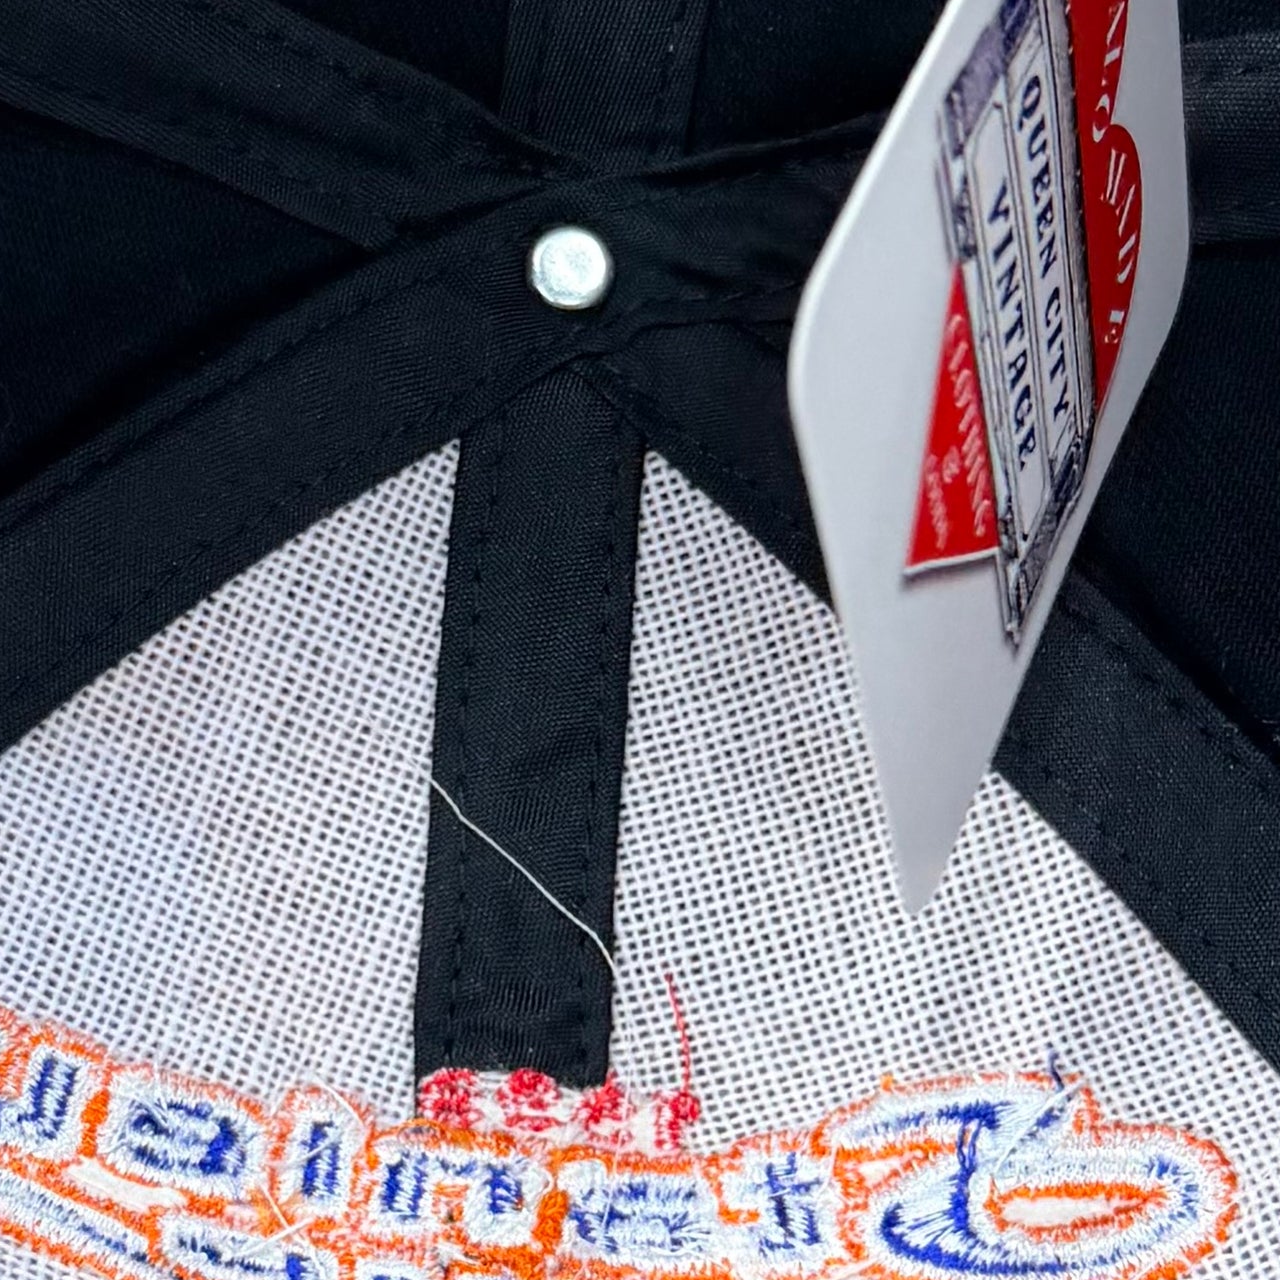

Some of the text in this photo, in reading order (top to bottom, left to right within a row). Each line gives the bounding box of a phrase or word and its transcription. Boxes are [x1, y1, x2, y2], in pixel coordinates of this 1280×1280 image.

[987, 176, 1038, 473] VINTAGE
[1019, 74, 1070, 420] QUEEN CITY
[1099, 146, 1138, 345] MADE
